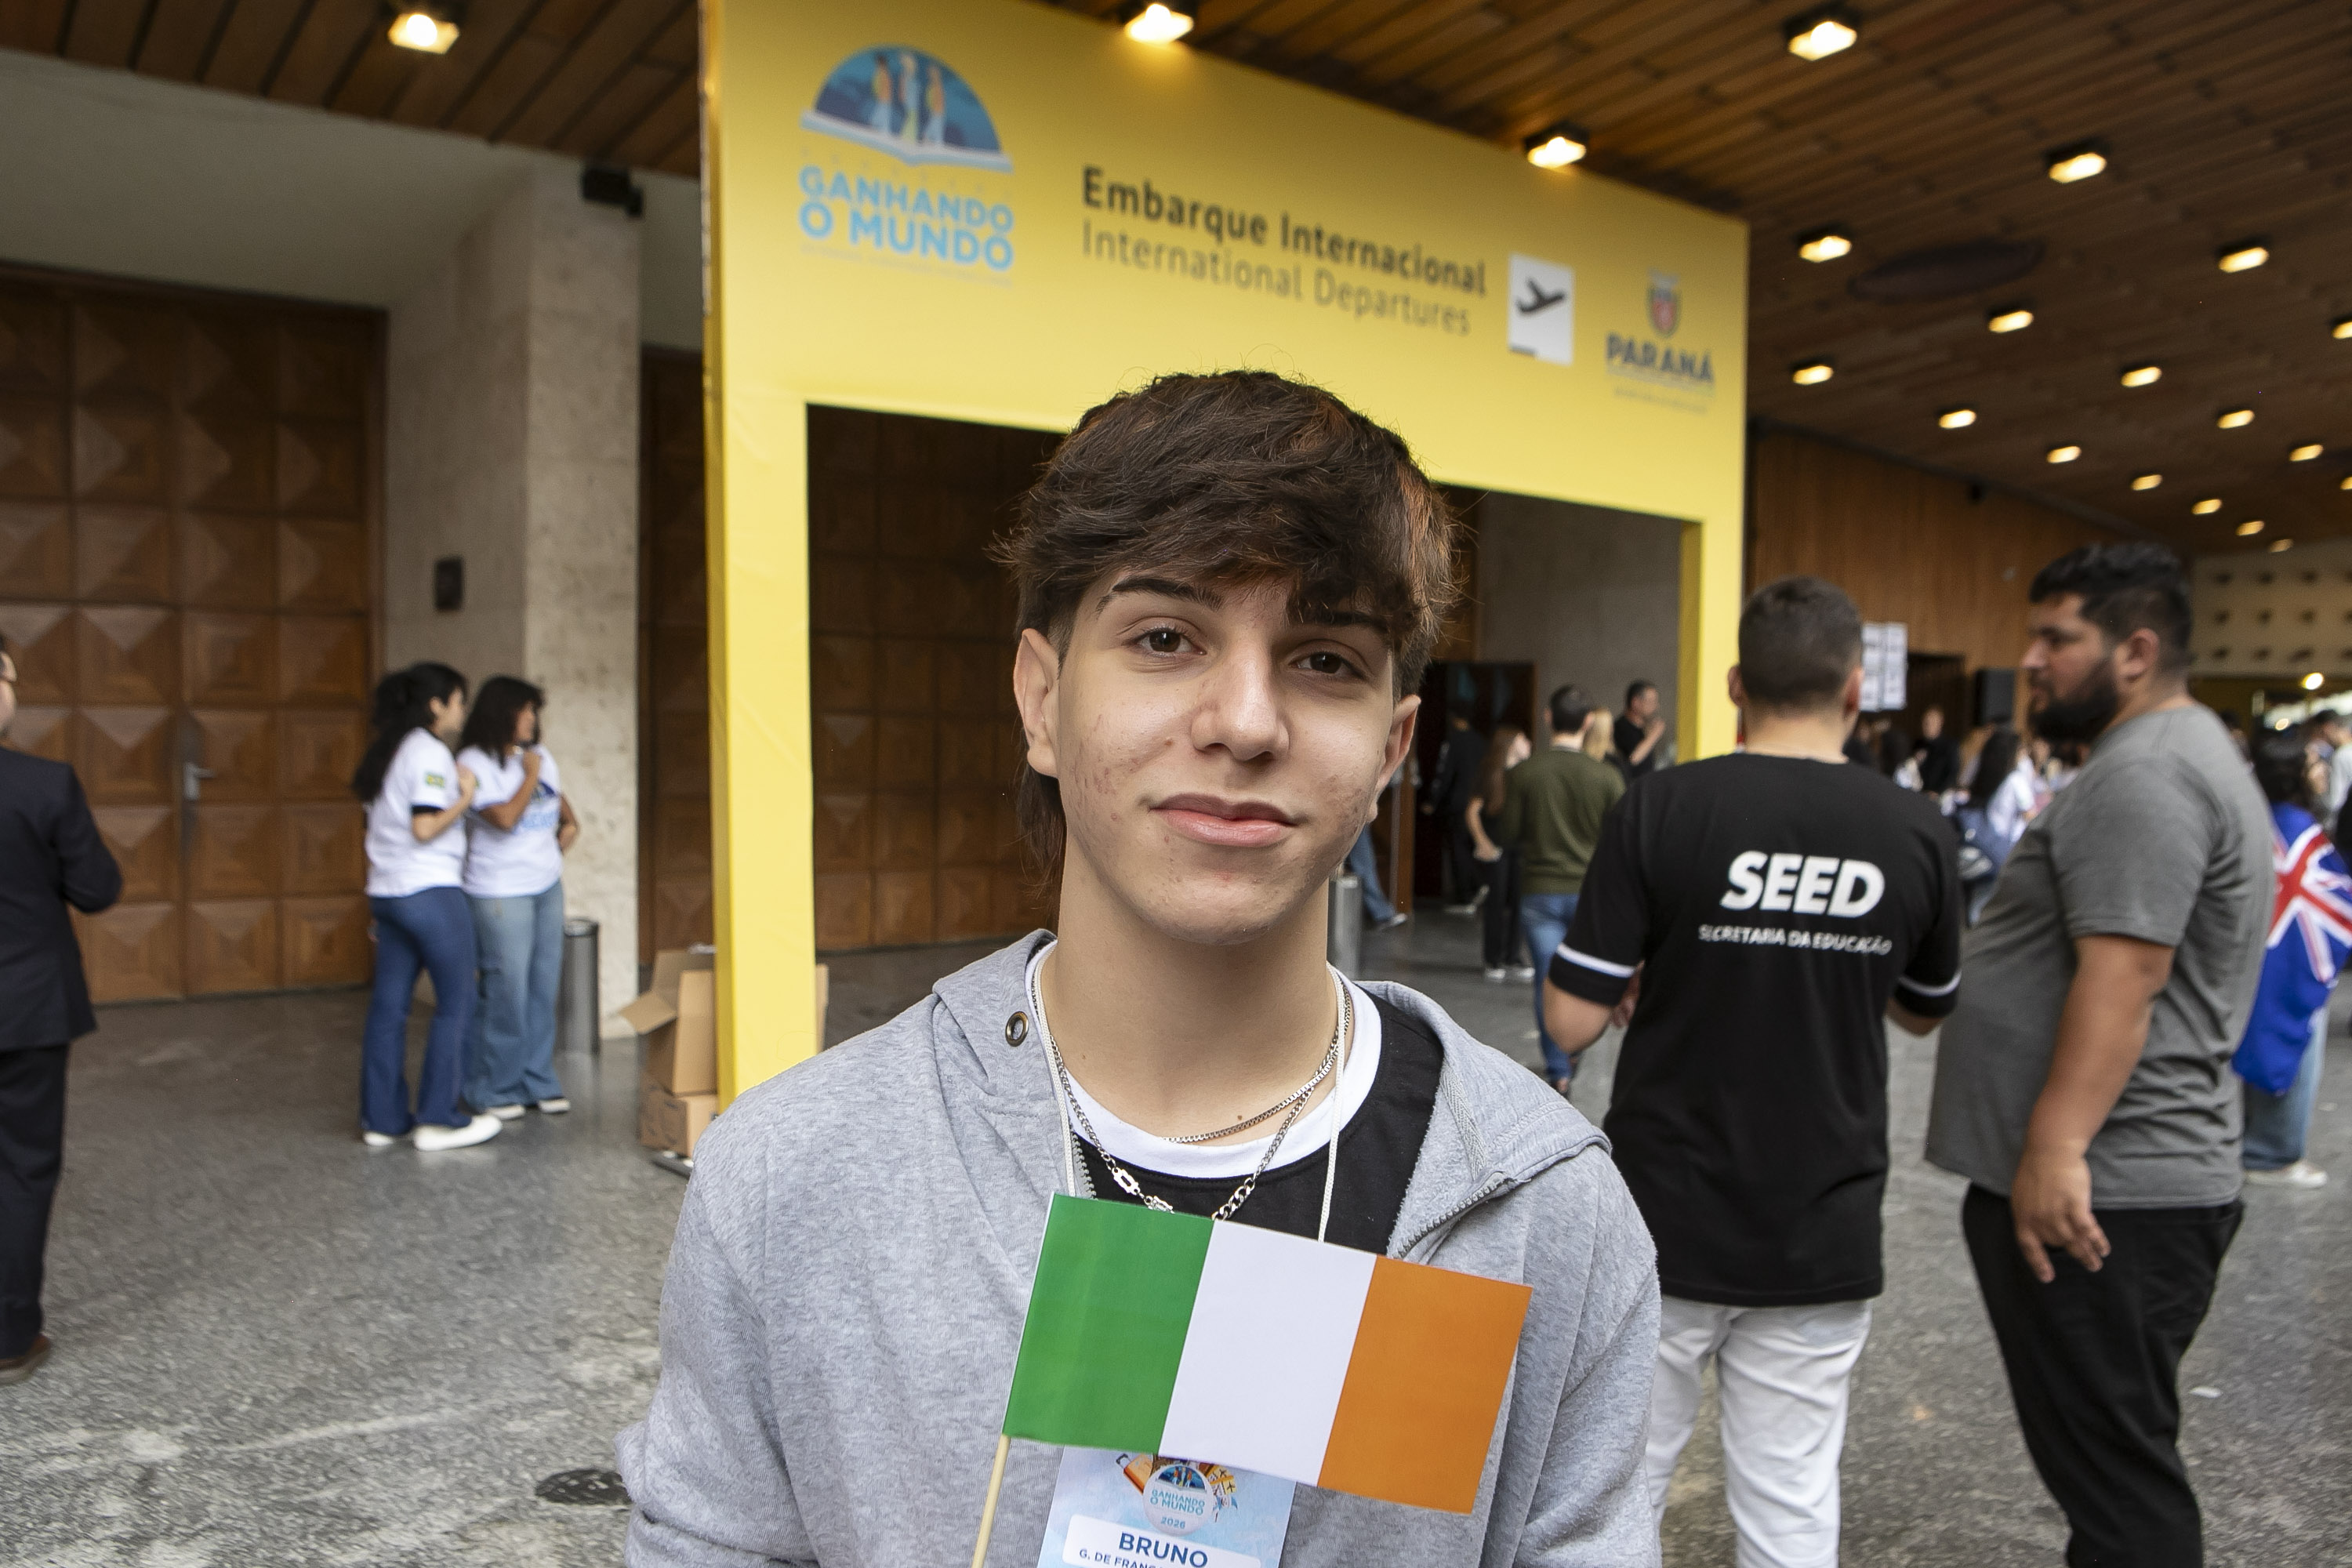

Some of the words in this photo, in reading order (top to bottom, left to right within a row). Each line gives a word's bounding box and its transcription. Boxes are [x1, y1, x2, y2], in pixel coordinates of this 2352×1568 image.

[798, 165, 1014, 234] GANHANDO
[798, 201, 834, 238] O
[849, 209, 1014, 272] MUNDO
[1082, 165, 1268, 246] Embarque
[1279, 210, 1486, 298] Internacional
[1082, 218, 1302, 302] International
[1312, 267, 1470, 337] Departures
[1719, 851, 1886, 918] SEED
[1788, 930, 1811, 948] DA
[1150, 1497, 1159, 1505] O
[1161, 1498, 1203, 1515] MUNDO
[1152, 1490, 1205, 1508] GANHANDO
[1160, 1517, 1186, 1530] 2026
[1079, 1548, 1091, 1560] G.
[1094, 1552, 1111, 1564] DE
[1119, 1532, 1208, 1568] BRUNO
